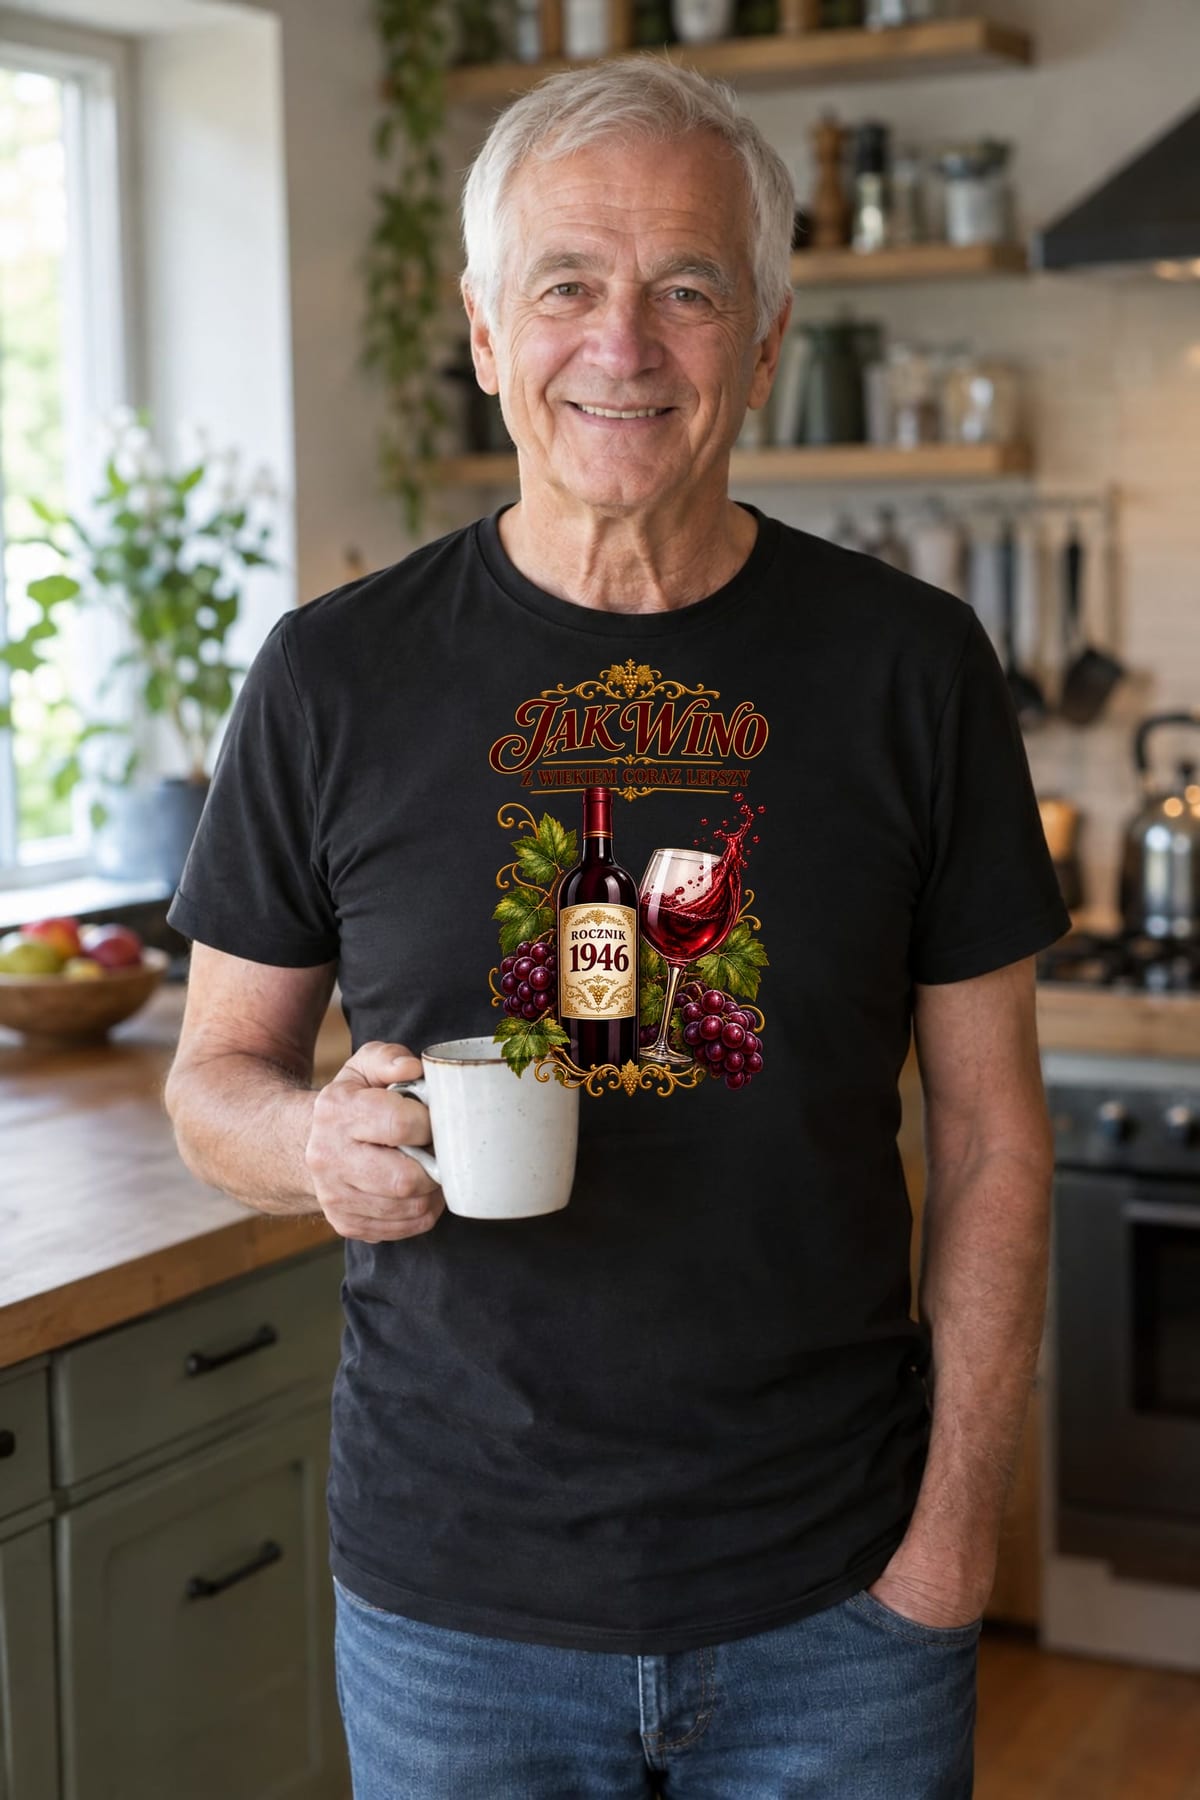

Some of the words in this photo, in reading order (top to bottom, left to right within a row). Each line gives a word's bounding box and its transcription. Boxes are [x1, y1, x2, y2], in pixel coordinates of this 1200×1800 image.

[488, 697, 625, 774] JAK
[620, 698, 769, 760] WINO
[520, 769, 534, 787] Z
[537, 769, 617, 786] WIEKIEM
[622, 768, 681, 786] CORAZ
[687, 769, 751, 787] LEPSZY
[571, 929, 627, 941] ROCZNIK
[569, 943, 629, 972] 1946
